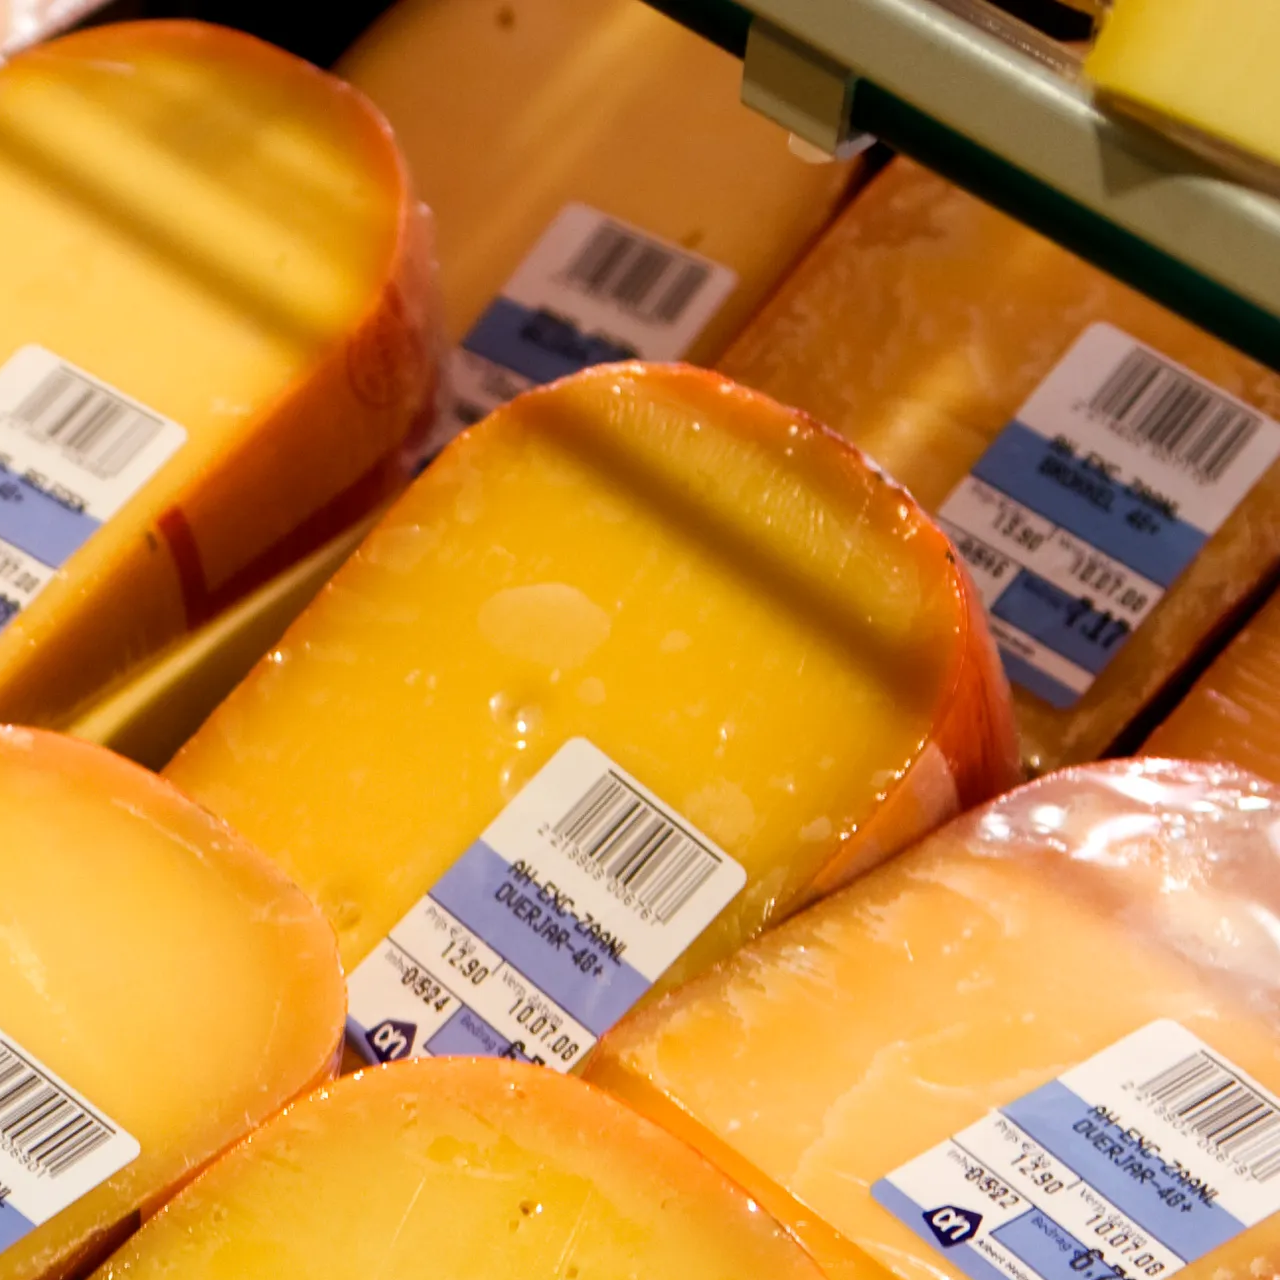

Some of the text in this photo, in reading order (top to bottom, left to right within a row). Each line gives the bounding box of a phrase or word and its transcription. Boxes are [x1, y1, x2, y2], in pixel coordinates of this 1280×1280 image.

[493, 883, 608, 977] OVERJAR-48+
[508, 859, 630, 964] AH-EXC-ZAANL
[438, 941, 489, 984] 12.90
[506, 999, 578, 1061] 10.07.08
[1072, 1119, 1195, 1214] OVERJAR-48+
[1088, 1104, 1222, 1207] AH-EXC-ZAANL
[1008, 1153, 1165, 1277] 12.90 10.07.08
